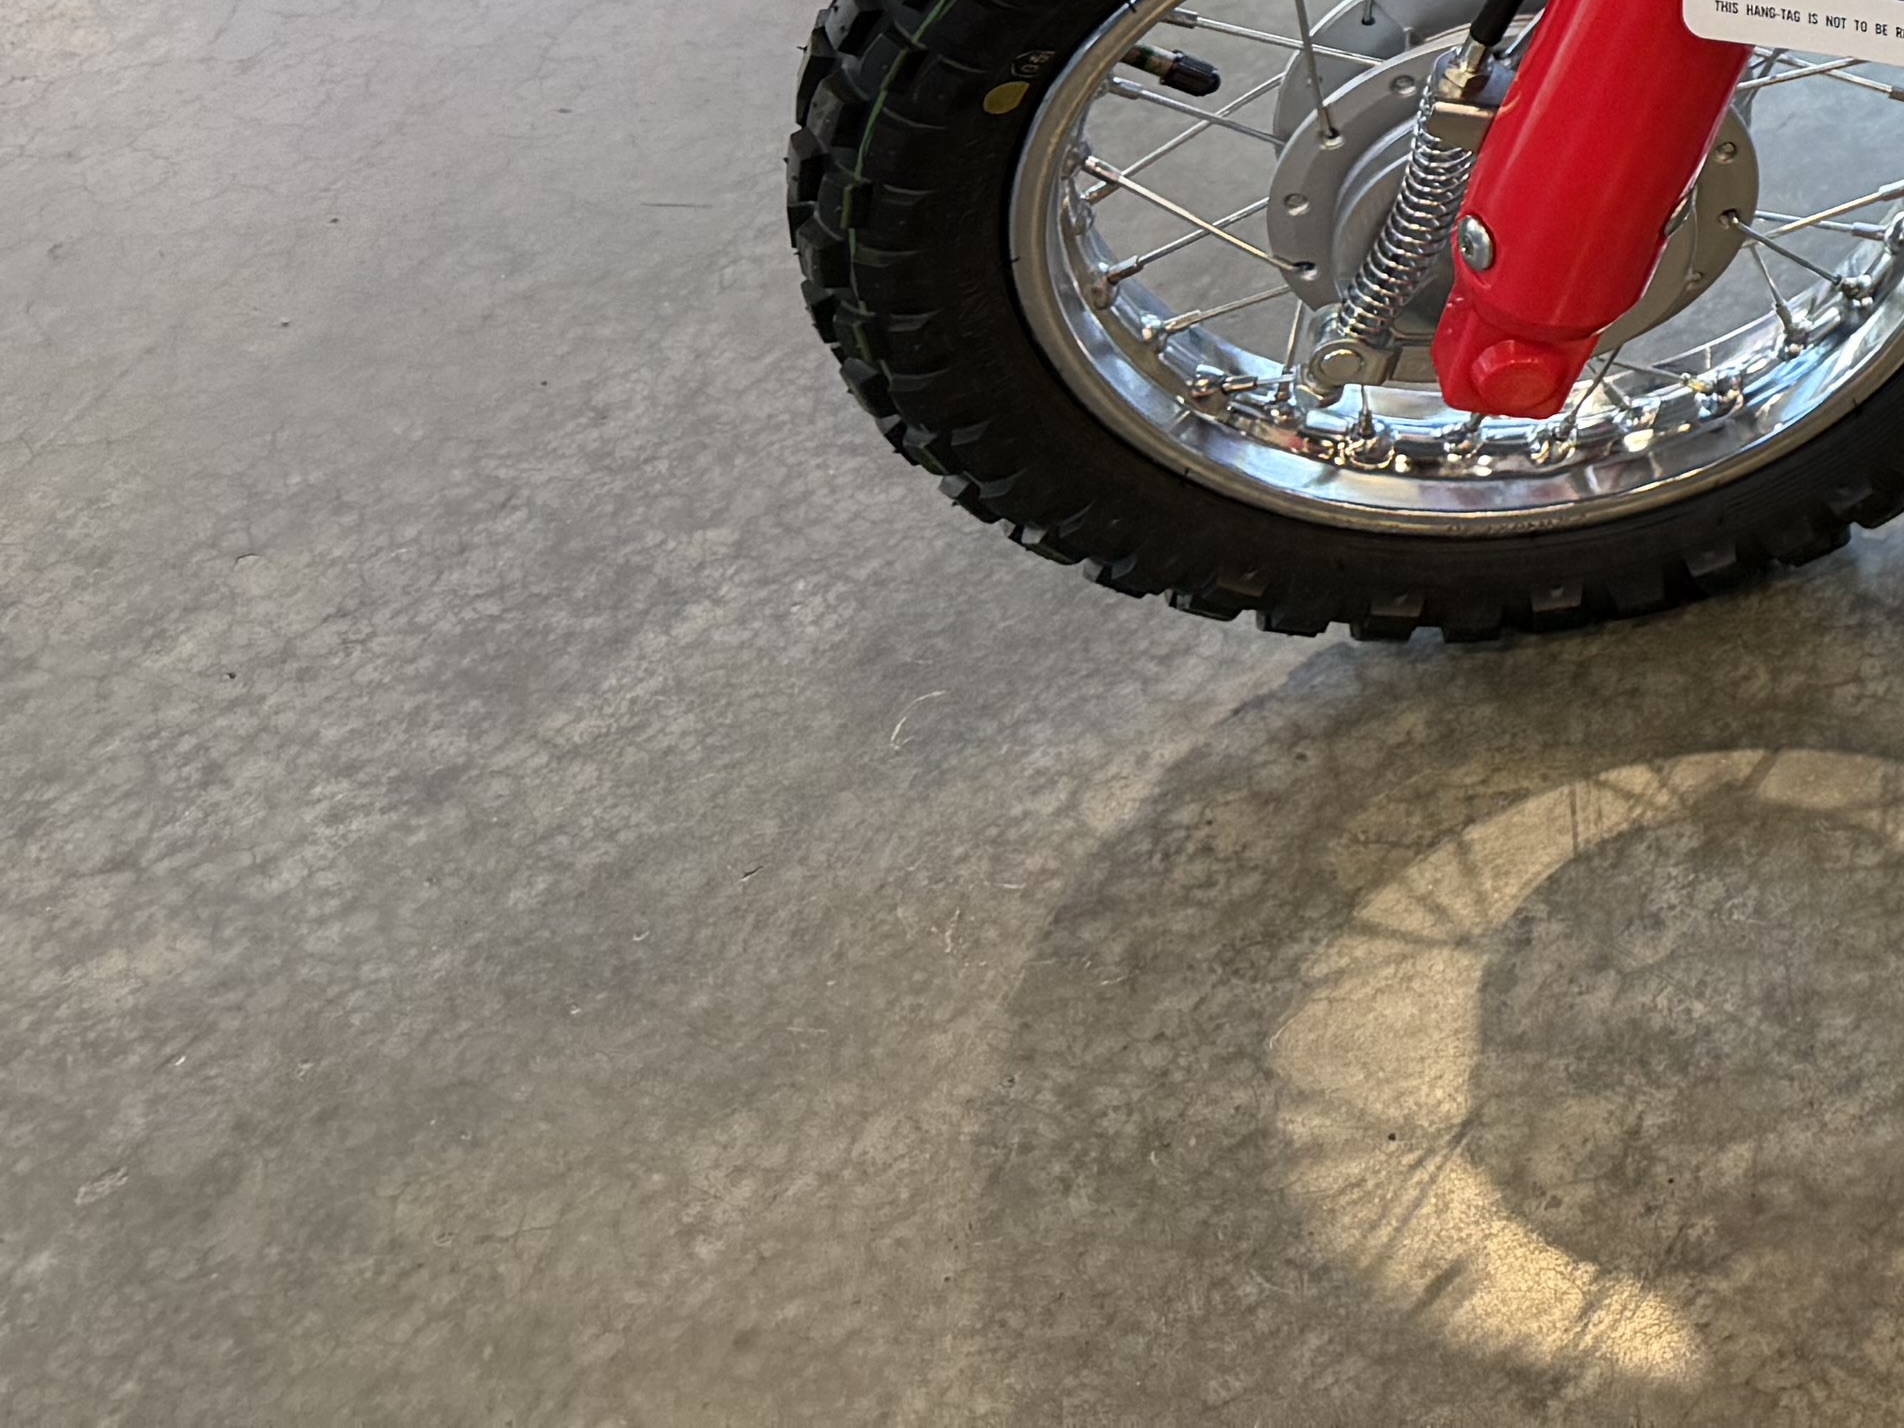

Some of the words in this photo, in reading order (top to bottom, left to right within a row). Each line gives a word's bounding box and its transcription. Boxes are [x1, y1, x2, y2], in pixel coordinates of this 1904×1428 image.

[1714, 0, 1739, 14] THIS
[1746, 3, 1801, 23] HANG-TAG
[1808, 12, 1819, 25] IS
[1825, 15, 1847, 30] NOT
[1854, 19, 1868, 33] TO
[1875, 23, 1889, 37] BE
